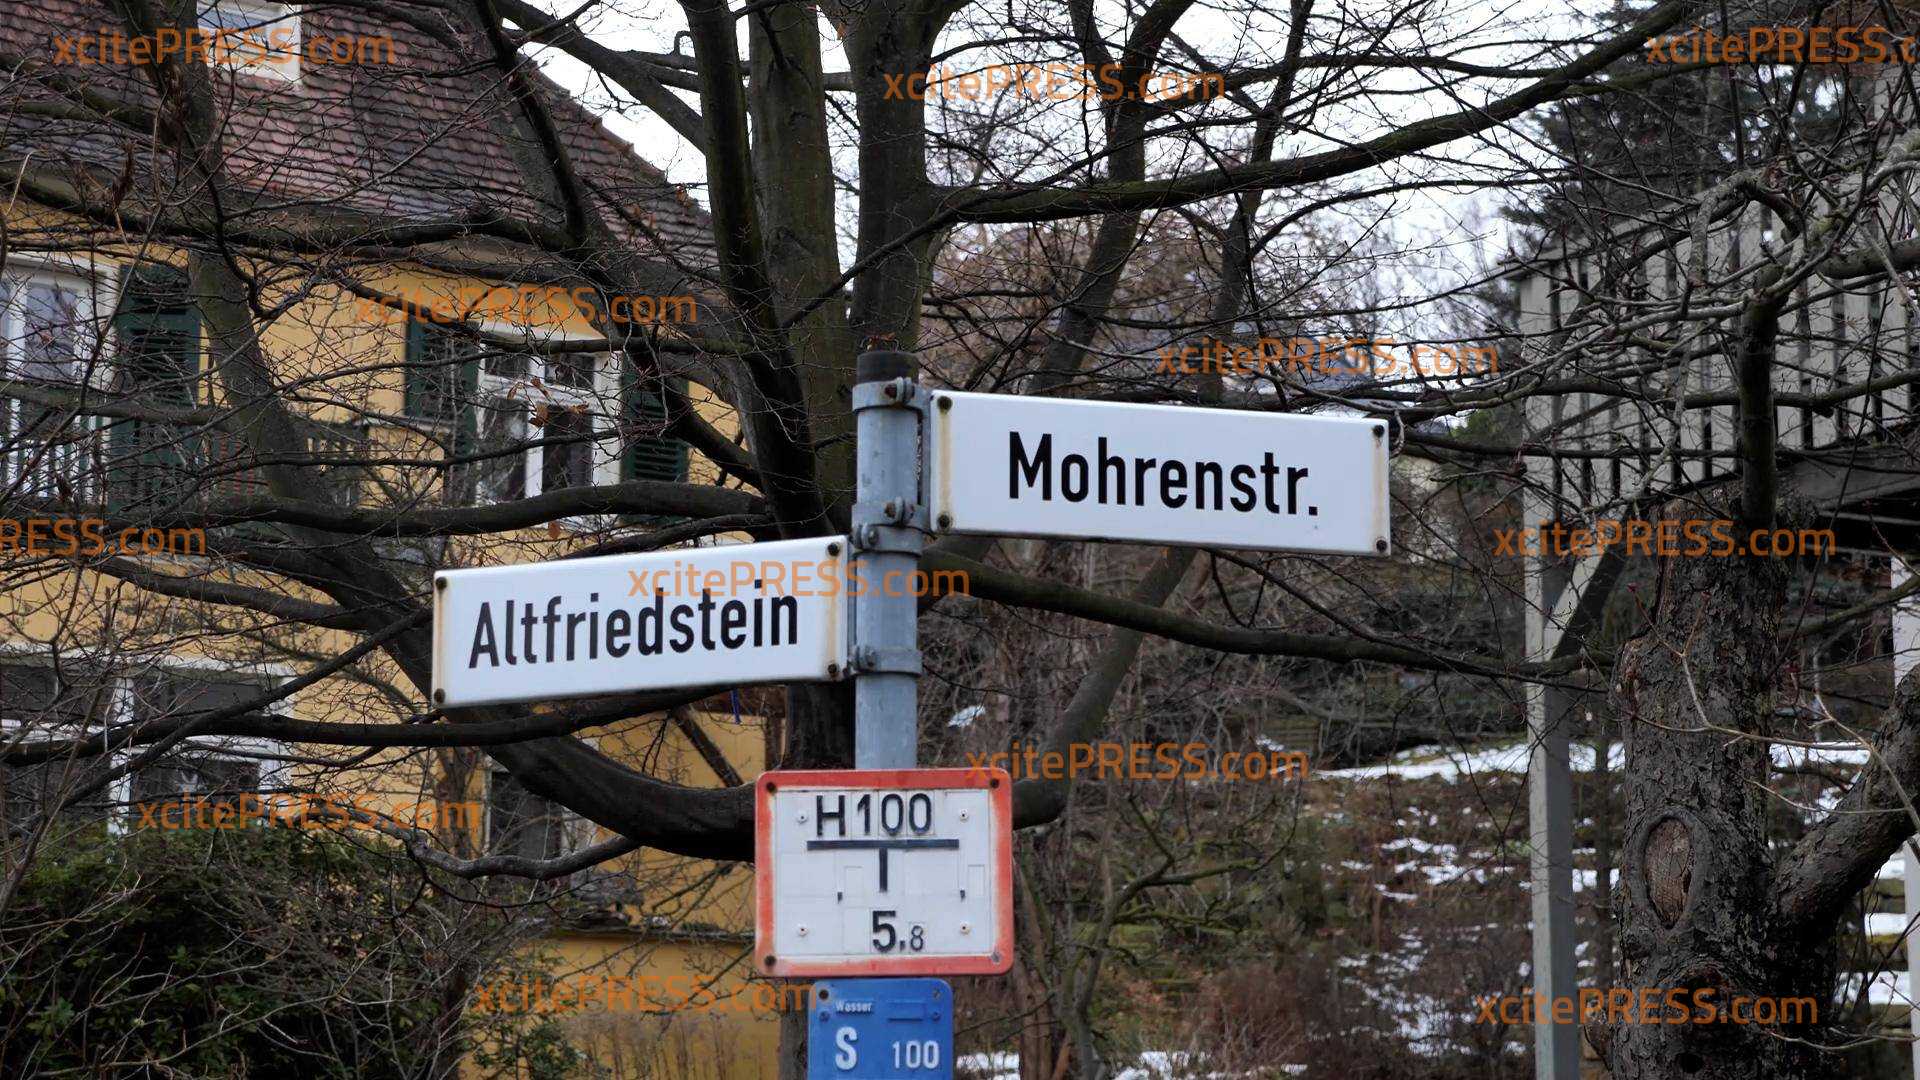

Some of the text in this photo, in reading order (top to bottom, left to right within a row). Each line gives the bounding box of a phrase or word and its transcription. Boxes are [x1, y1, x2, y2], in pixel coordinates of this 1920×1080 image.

[1008, 431, 1318, 516] Mohrenstr.
[468, 579, 798, 669] Altfriedstein
[816, 793, 932, 836] H100
[835, 1000, 873, 1013] Wasser
[835, 1026, 940, 1070] S 100
